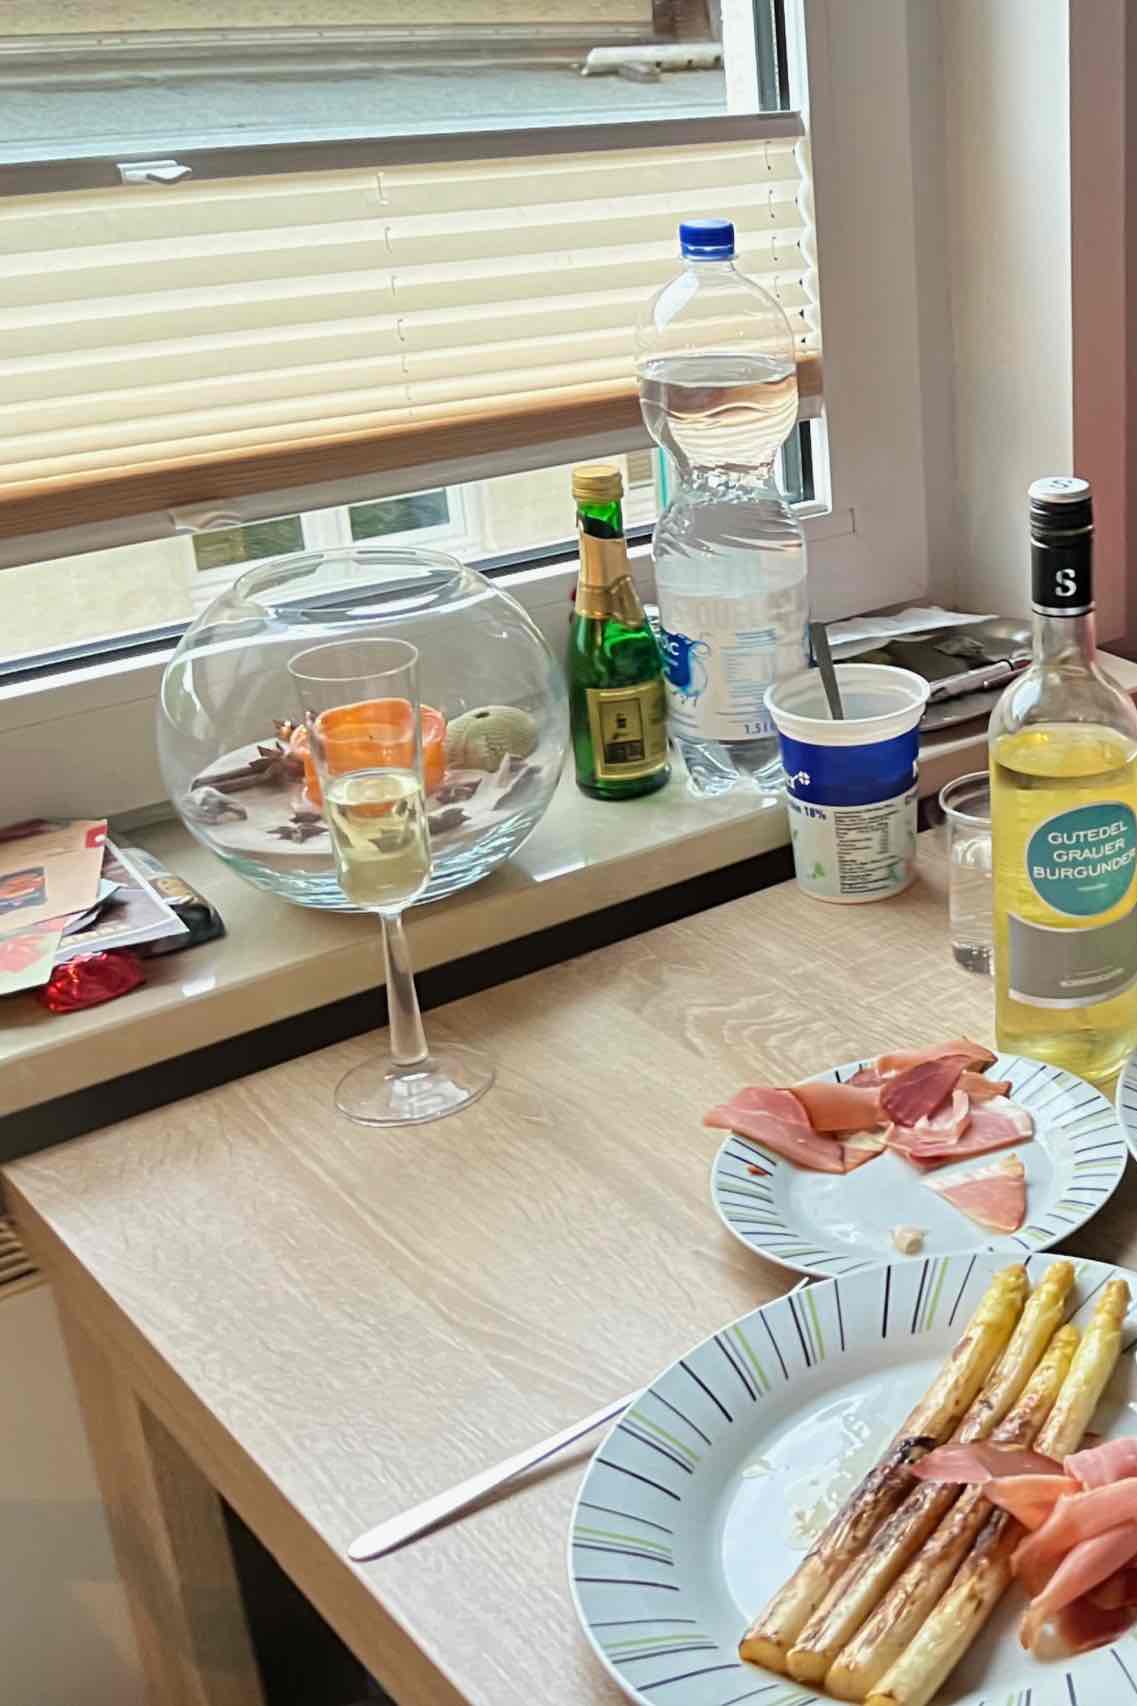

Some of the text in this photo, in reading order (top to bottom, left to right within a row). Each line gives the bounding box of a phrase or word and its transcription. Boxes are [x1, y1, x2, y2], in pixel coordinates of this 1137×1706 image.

[1055, 567, 1078, 598] S
[1047, 820, 1129, 845] GUTEDEL
[1032, 847, 1137, 881] BURGUNDER
[1053, 838, 1125, 863] GRAUER
